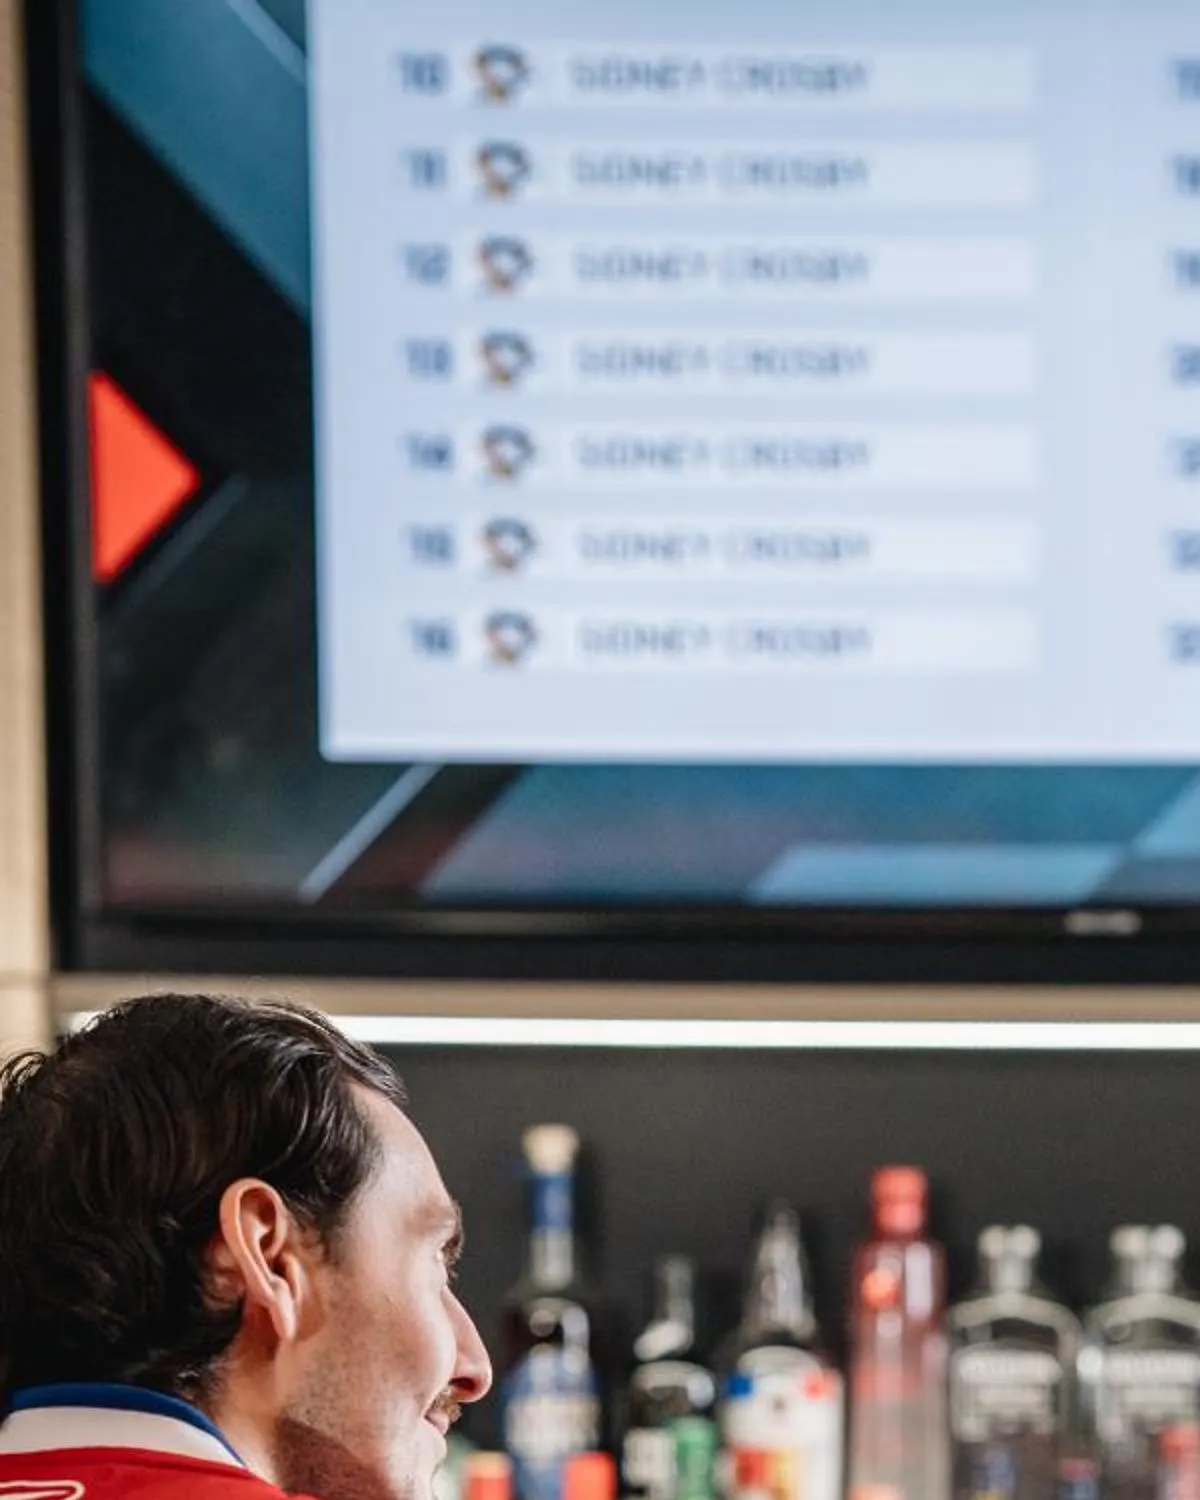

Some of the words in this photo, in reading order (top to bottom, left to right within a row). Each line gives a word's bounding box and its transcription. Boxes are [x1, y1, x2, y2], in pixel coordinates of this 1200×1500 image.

[570, 56, 706, 95] SIDNEY
[719, 56, 870, 95] CROSBY
[570, 153, 707, 189] SIDNEY
[720, 153, 869, 189] CROSBY
[573, 250, 709, 285] SIDNEY
[721, 250, 871, 285] CROSBY
[573, 344, 710, 378] SIDNEY
[722, 344, 872, 378] CROSBY
[575, 437, 711, 472] SIDNEY
[723, 437, 872, 472] CROSBY
[577, 529, 711, 564] SIDNEY
[724, 529, 872, 564] CROSBY
[578, 621, 713, 657] SIDNEY
[725, 621, 873, 657] CROSBY
